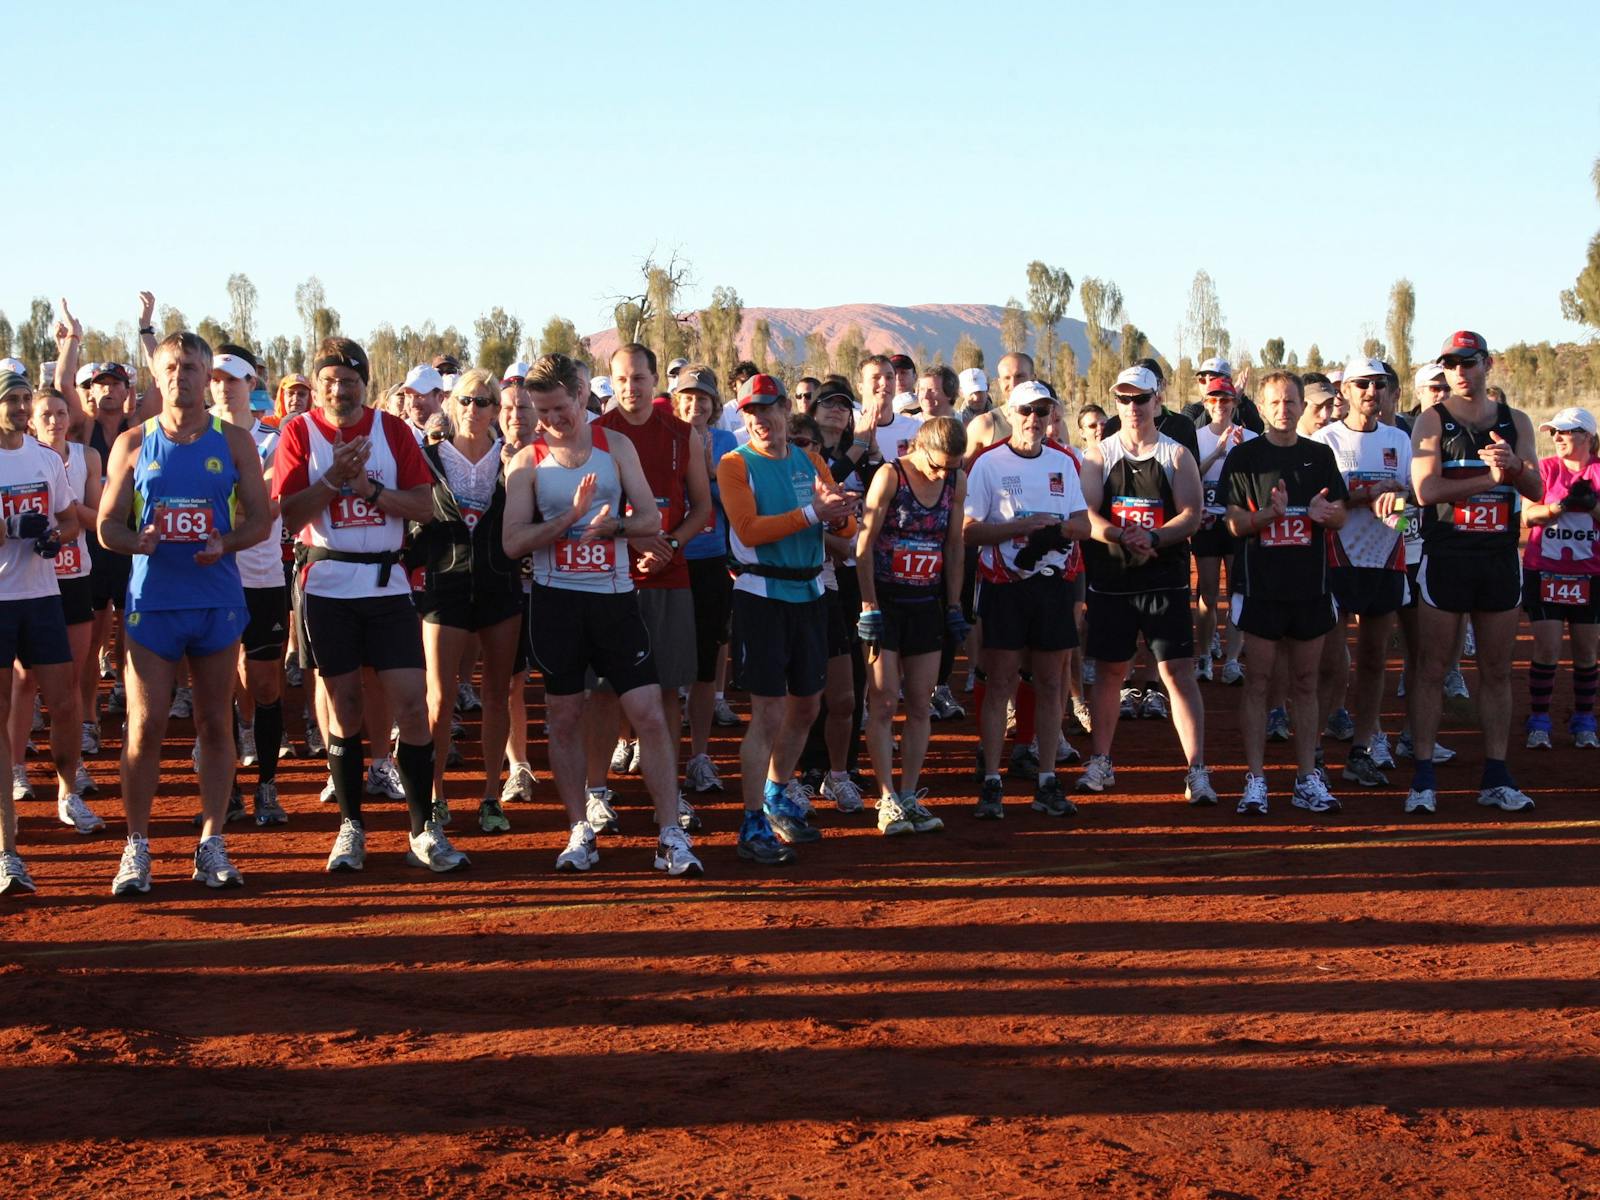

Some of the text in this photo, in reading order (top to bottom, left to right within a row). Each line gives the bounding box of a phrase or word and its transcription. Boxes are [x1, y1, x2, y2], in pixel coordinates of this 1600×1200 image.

[4, 497, 43, 517] 145
[338, 497, 380, 518] 162
[1461, 505, 1498, 524] 121
[163, 511, 207, 534] 163
[1117, 510, 1155, 529] 135
[1267, 519, 1305, 538] 112
[562, 544, 606, 565] 138
[902, 553, 938, 573] 177
[1546, 583, 1582, 598] 144
